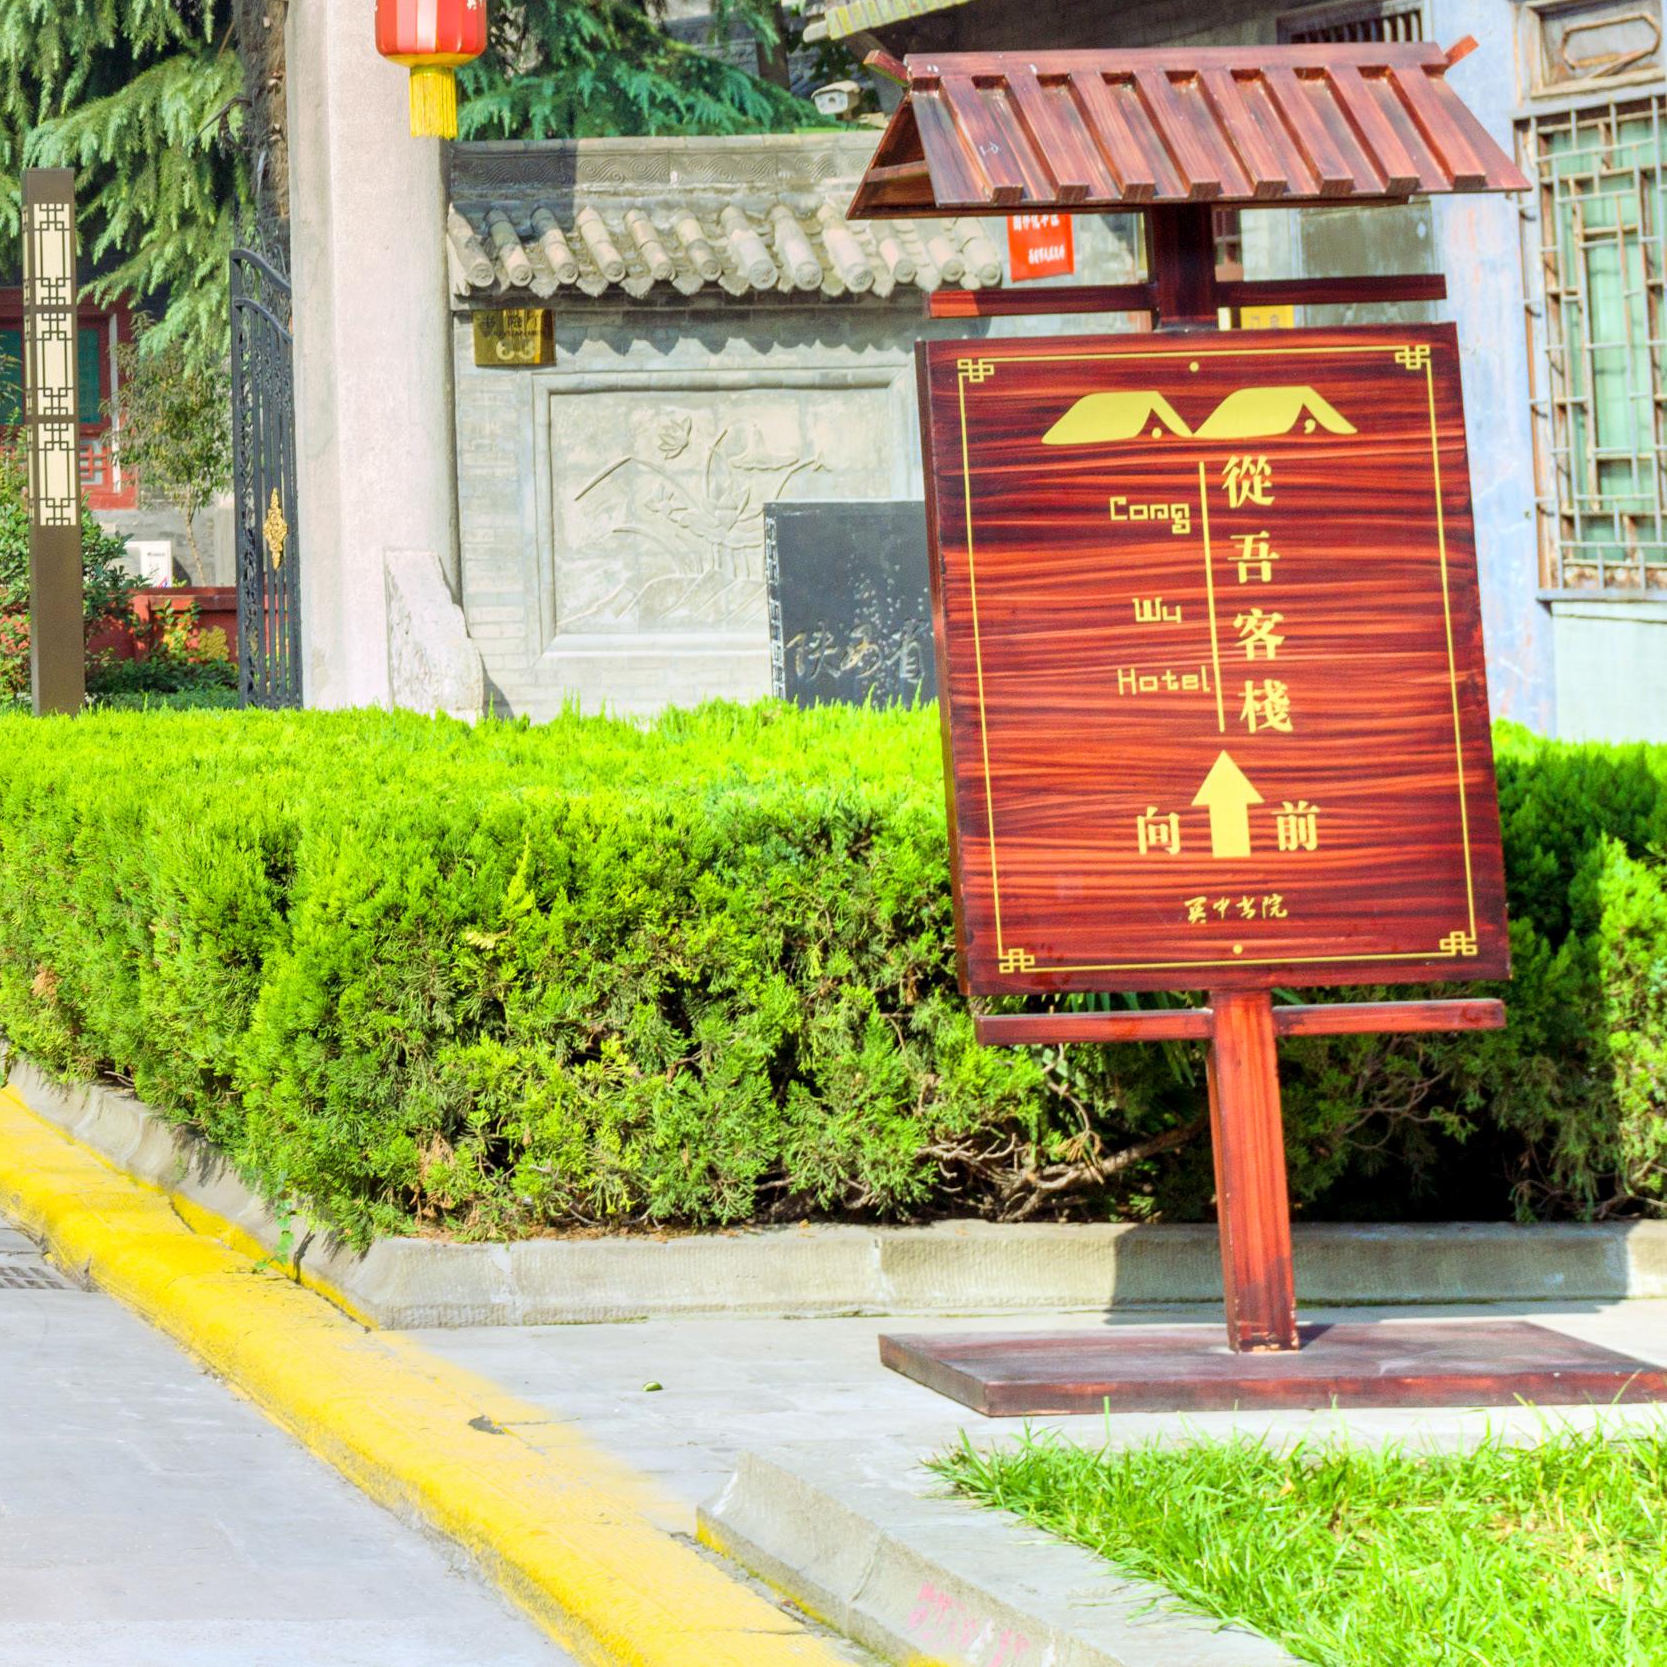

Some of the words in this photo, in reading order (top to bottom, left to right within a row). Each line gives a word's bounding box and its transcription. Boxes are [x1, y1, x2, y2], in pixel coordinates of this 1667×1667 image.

[1109, 495, 1192, 535] Cong
[1131, 595, 1182, 624] Wu
[1117, 664, 1211, 696] Hotel
[1136, 806, 1181, 856] 向
[1270, 800, 1321, 852] 前
